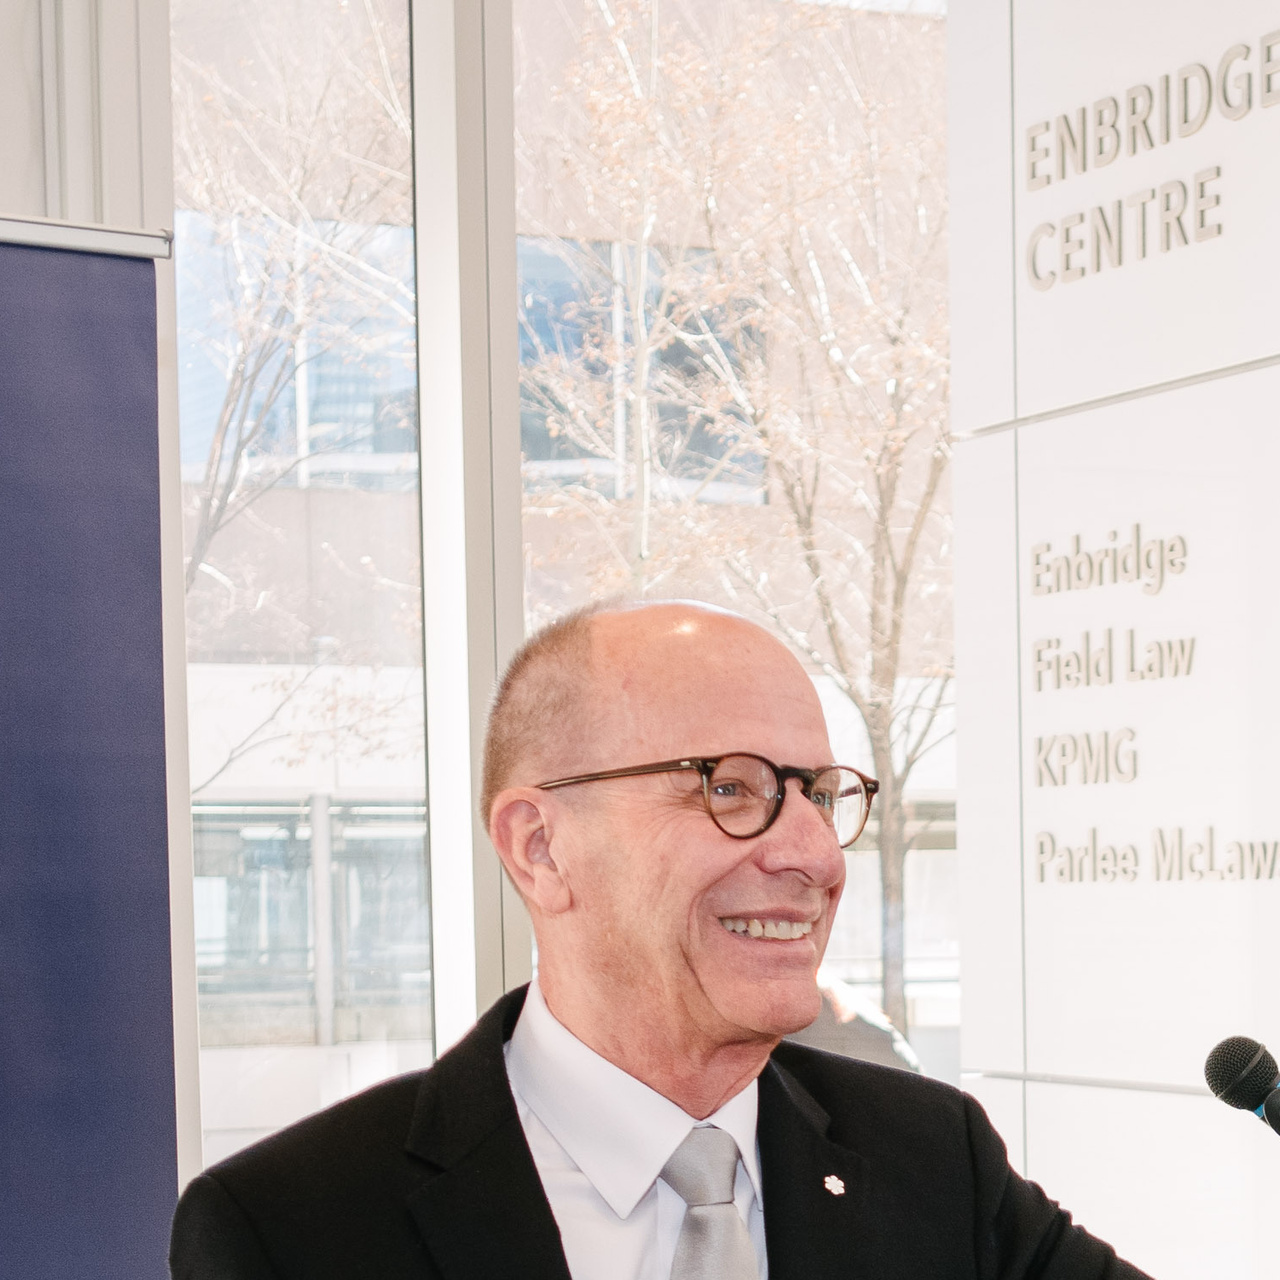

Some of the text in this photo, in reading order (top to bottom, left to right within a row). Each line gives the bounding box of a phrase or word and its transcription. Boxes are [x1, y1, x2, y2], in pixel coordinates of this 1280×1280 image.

[1026, 165, 1223, 292] CENTRE
[1031, 522, 1188, 596] Enbridge
[1033, 627, 1197, 693] Field Law
[1034, 726, 1140, 788] KPMG
[1035, 826, 1140, 884] Parlee
